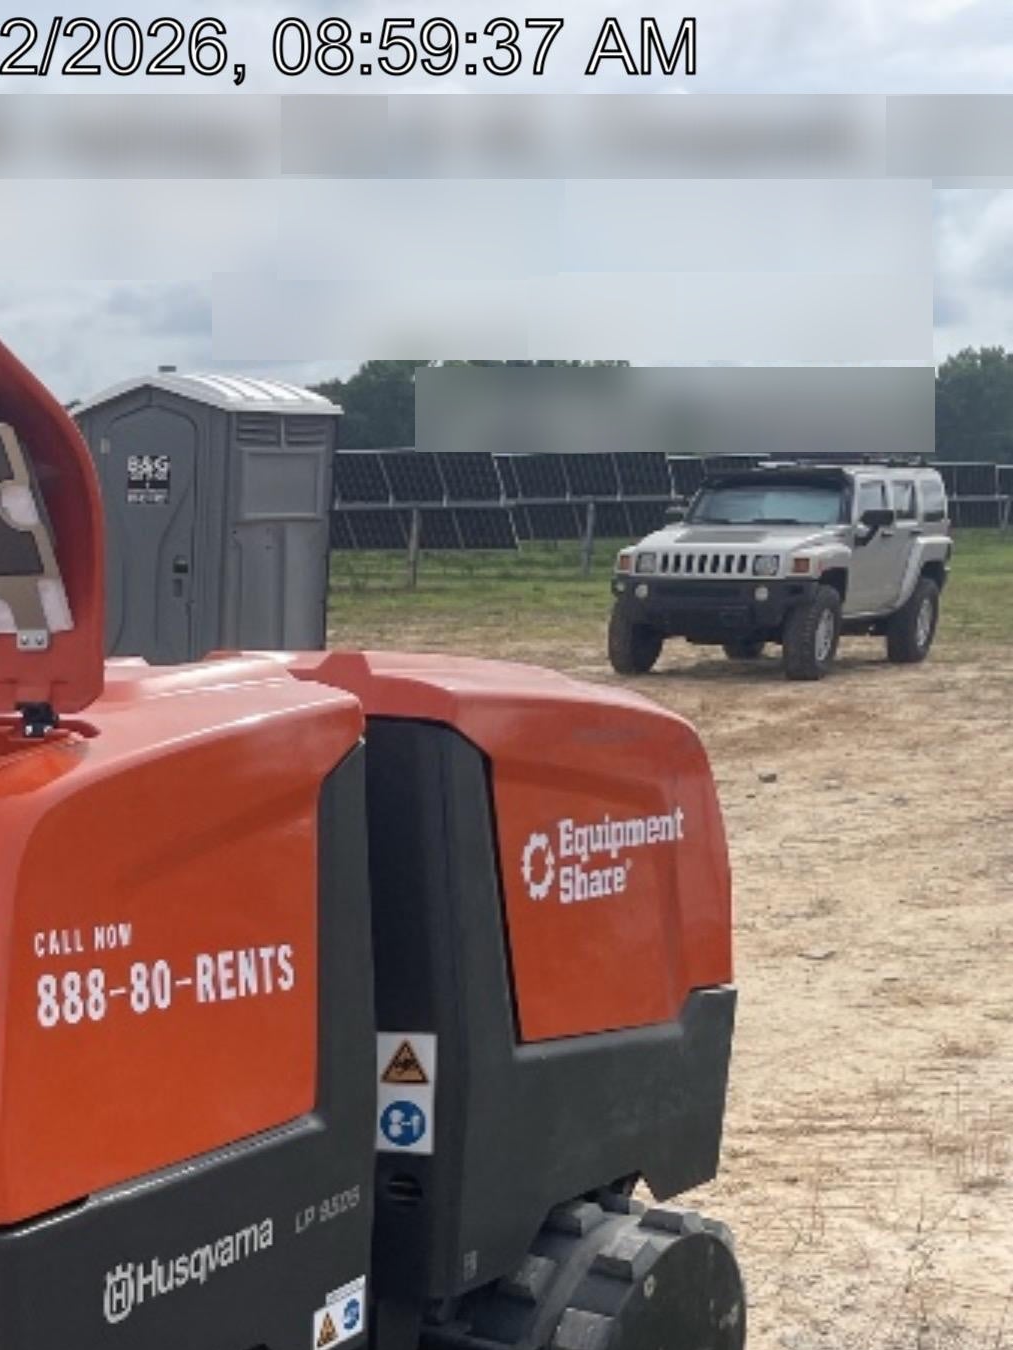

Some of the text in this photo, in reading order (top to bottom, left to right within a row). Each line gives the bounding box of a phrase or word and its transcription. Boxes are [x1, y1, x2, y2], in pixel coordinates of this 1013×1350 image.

[557, 807, 684, 863] Equipment
[559, 862, 628, 904] Share
[34, 923, 132, 957] CALL NOW
[37, 944, 295, 1028] 888-80-RENTS
[295, 1206, 315, 1234] LP
[136, 1217, 274, 1304] Husqvarna
